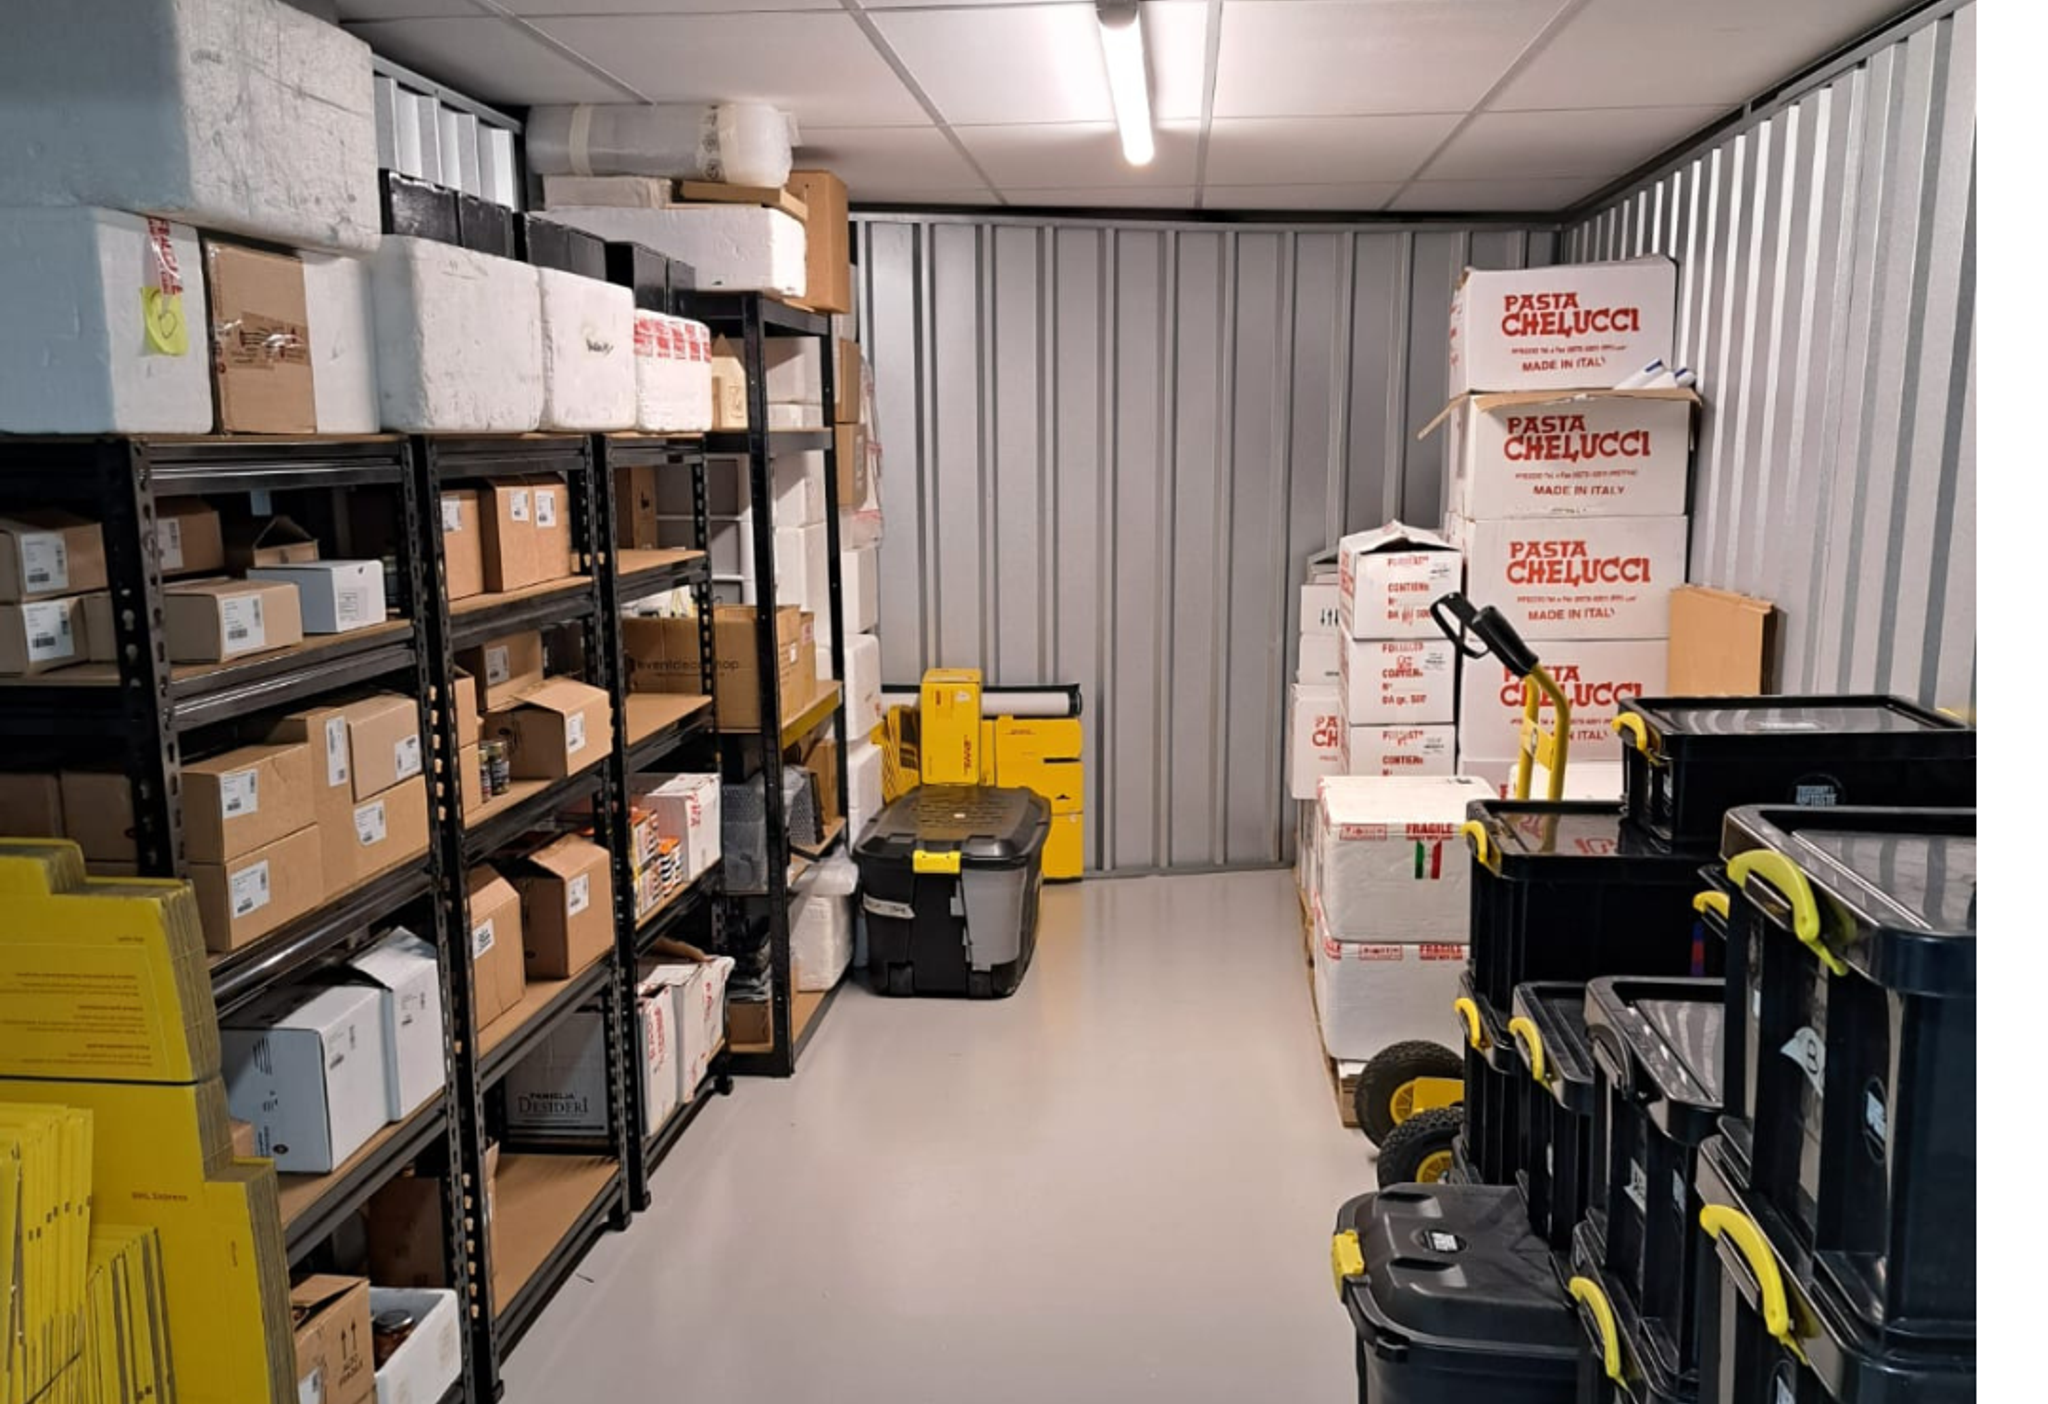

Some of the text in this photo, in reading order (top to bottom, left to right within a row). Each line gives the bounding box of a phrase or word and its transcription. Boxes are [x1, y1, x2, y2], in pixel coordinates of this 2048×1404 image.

[1504, 292, 1578, 312] PASTA
[1501, 307, 1640, 338] CHELUCCI
[1522, 360, 1556, 371] MADE
[1560, 358, 1573, 369] IN
[1507, 414, 1586, 434] PASTA
[1504, 430, 1651, 462] CHELUCCI
[1533, 485, 1625, 495] MADE IN ITALY
[1510, 540, 1587, 559] PASTA
[1507, 556, 1651, 587] CHELUCCI
[1528, 609, 1565, 621] MADE
[1568, 608, 1581, 619] IN
[1405, 823, 1453, 834] FRAGILE
